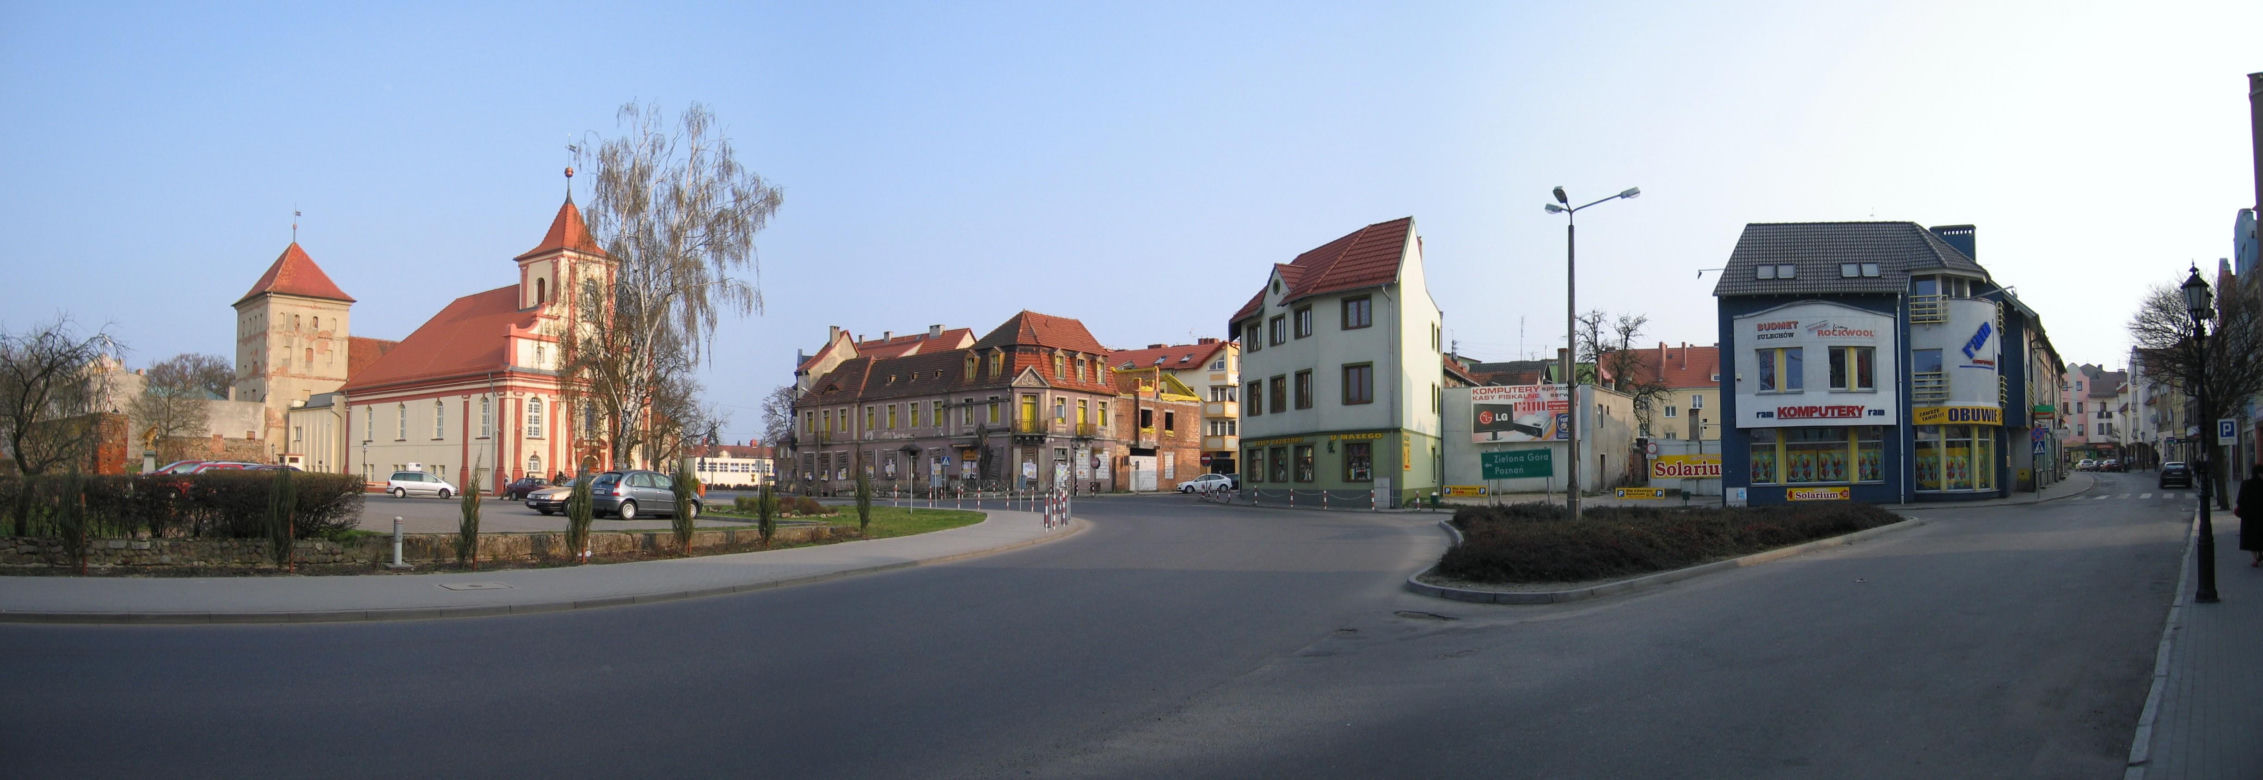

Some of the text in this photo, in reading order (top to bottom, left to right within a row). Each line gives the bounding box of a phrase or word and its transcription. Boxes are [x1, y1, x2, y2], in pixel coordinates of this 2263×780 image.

[1757, 320, 1799, 332] BUDMET
[1817, 328, 1875, 337] ROCKWOOL
[1472, 386, 1541, 395] KOMPUTERY
[1495, 413, 1509, 422] LG
[1756, 411, 1775, 419] ram
[1777, 405, 1865, 419] KOMPUTERY
[1948, 407, 1998, 423] OBUWIE
[2222, 423, 2232, 436] P
[1494, 454, 1525, 464] Zielona
[1495, 464, 1524, 475] Poznań
[1655, 461, 1721, 477] Solariu
[1795, 491, 1839, 499] Solarium
